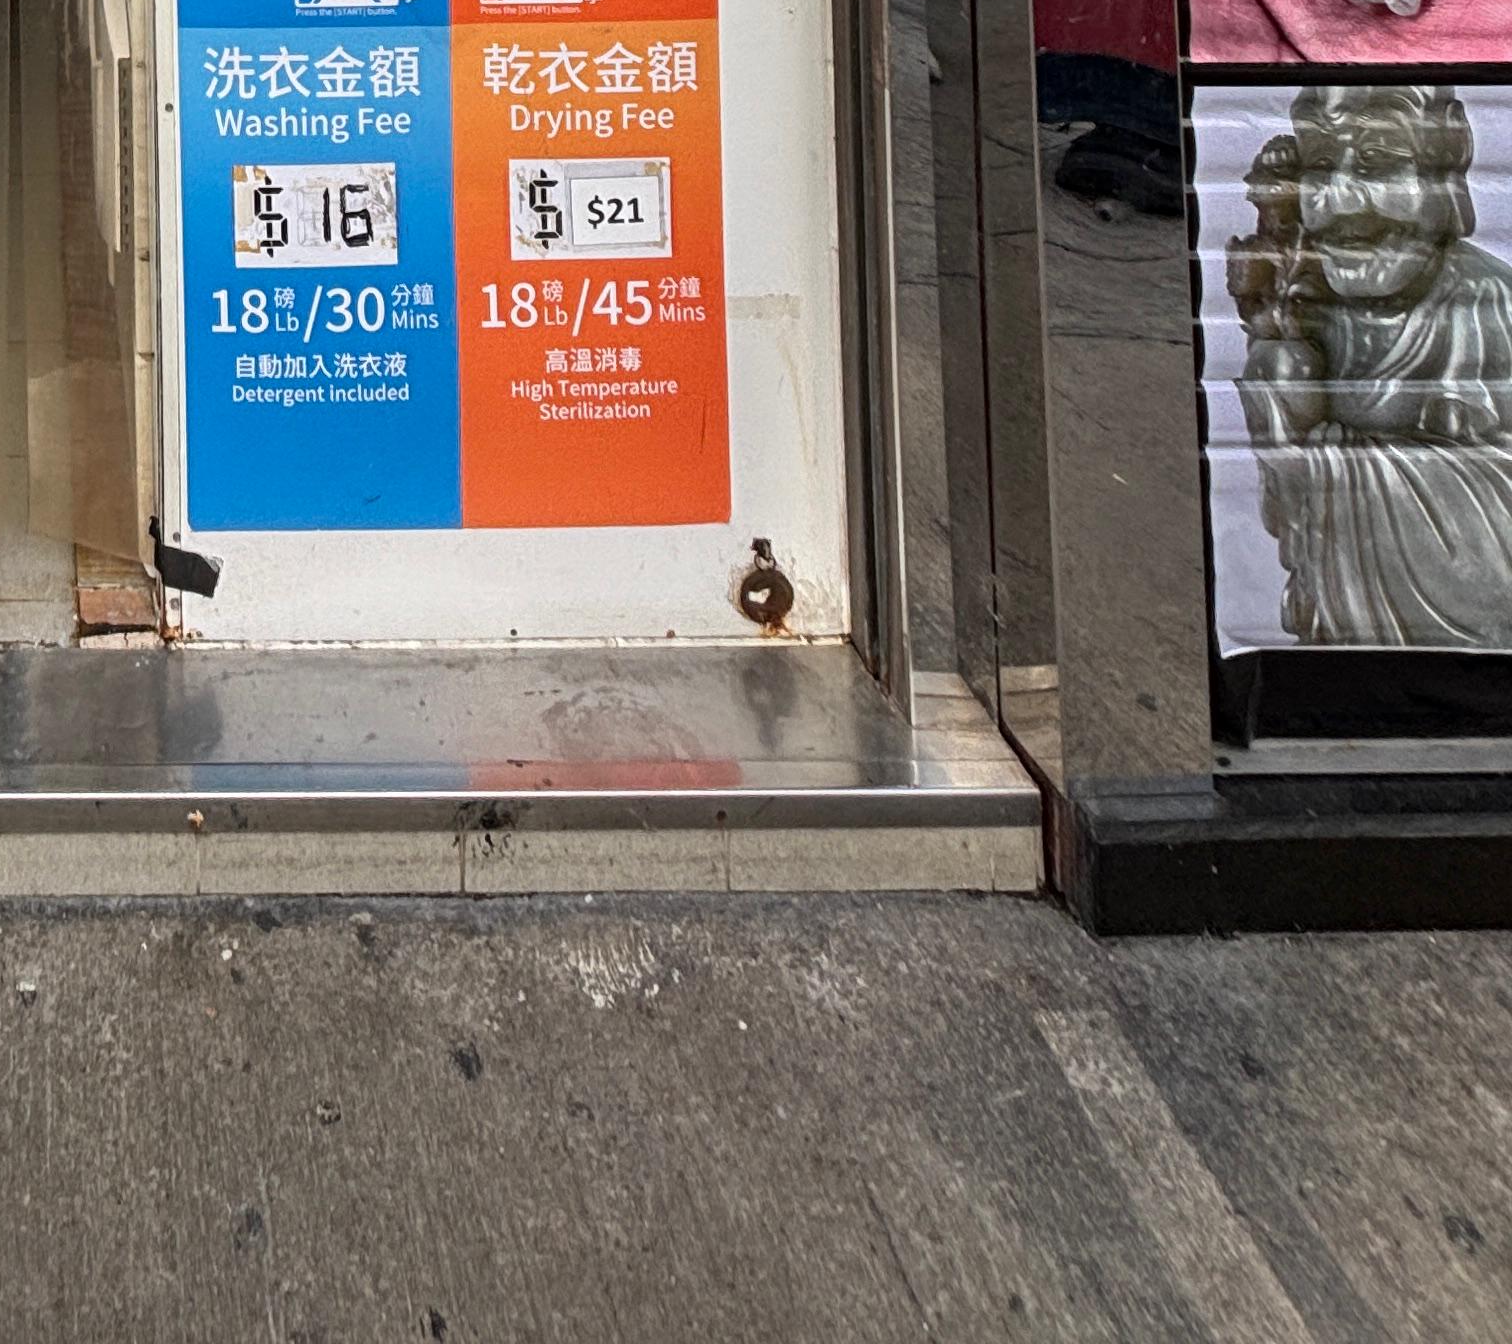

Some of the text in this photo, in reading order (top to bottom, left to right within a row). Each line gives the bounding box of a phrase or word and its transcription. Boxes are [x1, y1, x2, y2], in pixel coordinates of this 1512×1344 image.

[204, 46, 420, 99] 洗衣金額
[483, 41, 698, 96] 乾衣金額
[216, 107, 411, 141] Washing Fee
[510, 103, 675, 138] Drying Fee
[323, 184, 374, 248] 16
[587, 197, 644, 229] $21
[211, 288, 269, 334] 18
[274, 287, 295, 309] 磅
[391, 282, 434, 307] 分鐘
[481, 282, 538, 328] 18
[542, 279, 563, 303] 磅
[658, 277, 701, 299] 分鐘
[544, 302, 706, 325] Lb Mins
[275, 309, 439, 331] Lb Mins
[236, 352, 407, 379] 自動加入洗衣液
[545, 346, 642, 373] 高溫消毒
[232, 383, 410, 407] Detergent included
[511, 379, 678, 402] High Temperature
[539, 401, 651, 420] Sterilization
